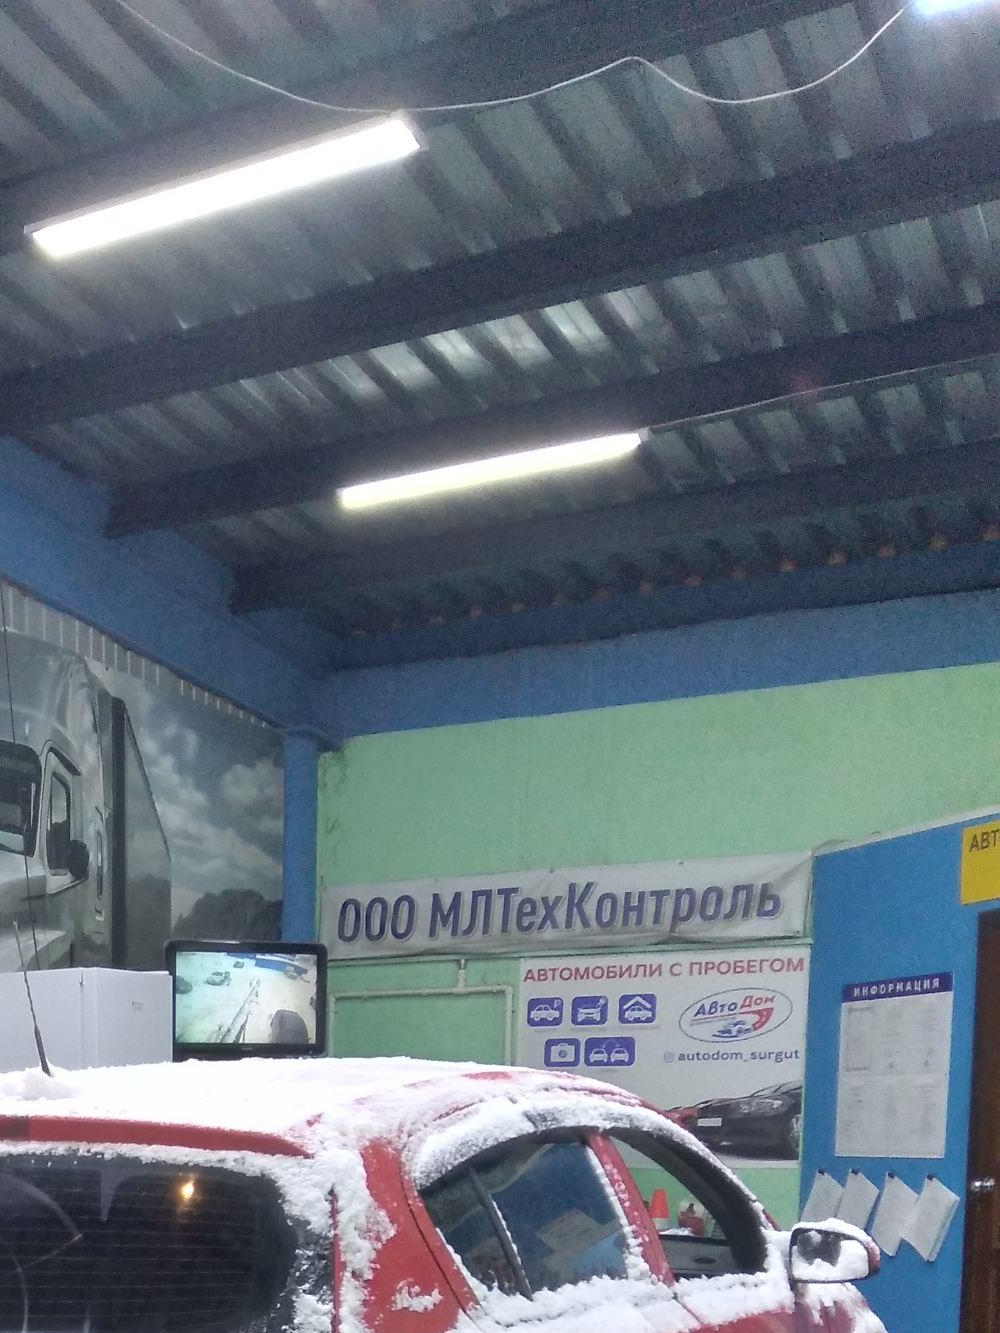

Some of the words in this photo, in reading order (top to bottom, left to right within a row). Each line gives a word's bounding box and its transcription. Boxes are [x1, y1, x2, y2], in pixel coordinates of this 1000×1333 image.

[337, 895, 417, 944] ООО
[428, 880, 784, 938] МЛТехКонтроль
[523, 963, 663, 983] АВТОМОБИЛИ
[669, 962, 683, 976] С
[689, 957, 804, 976] ПРОБЕГОМ
[853, 977, 940, 998] ИНФОРМАЦИЯ
[678, 1049, 800, 1063] autodom_surgut
